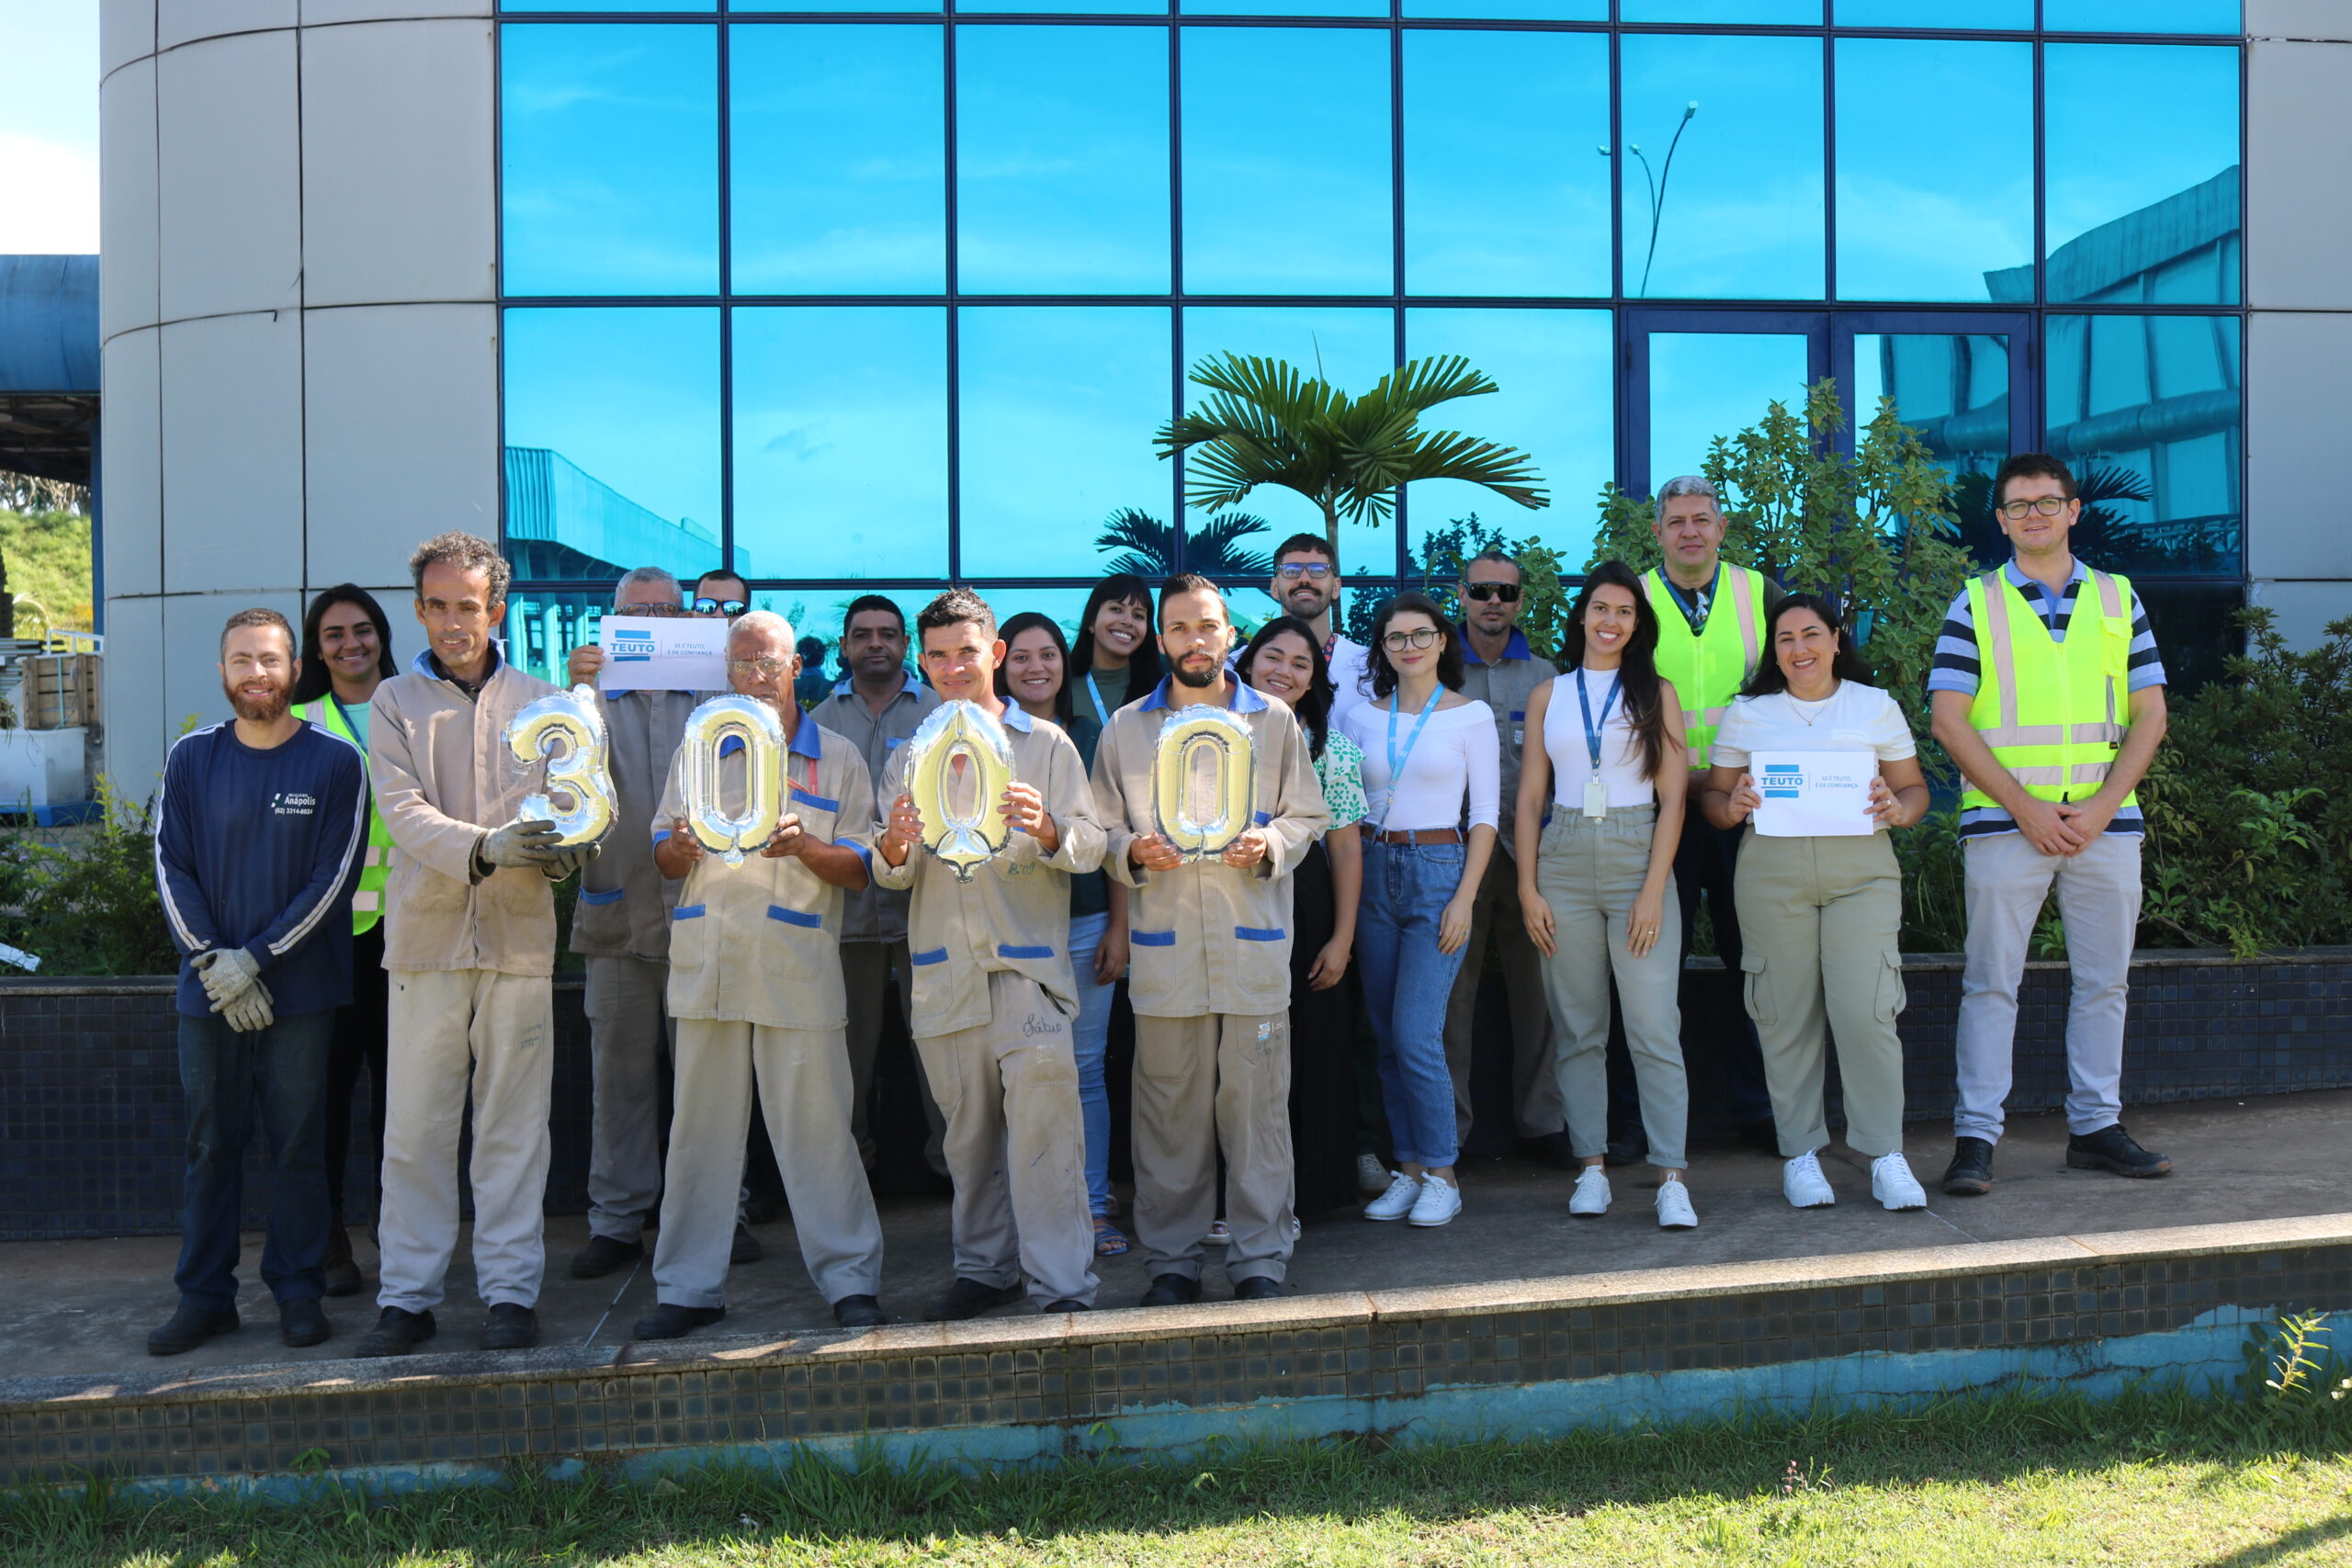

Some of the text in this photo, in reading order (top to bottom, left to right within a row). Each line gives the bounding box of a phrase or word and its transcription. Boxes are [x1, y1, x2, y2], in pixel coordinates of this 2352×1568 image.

[610, 643, 655, 653] TEUTO
[1760, 777, 1804, 785] TEUTO
[284, 795, 316, 807] Anápolis
